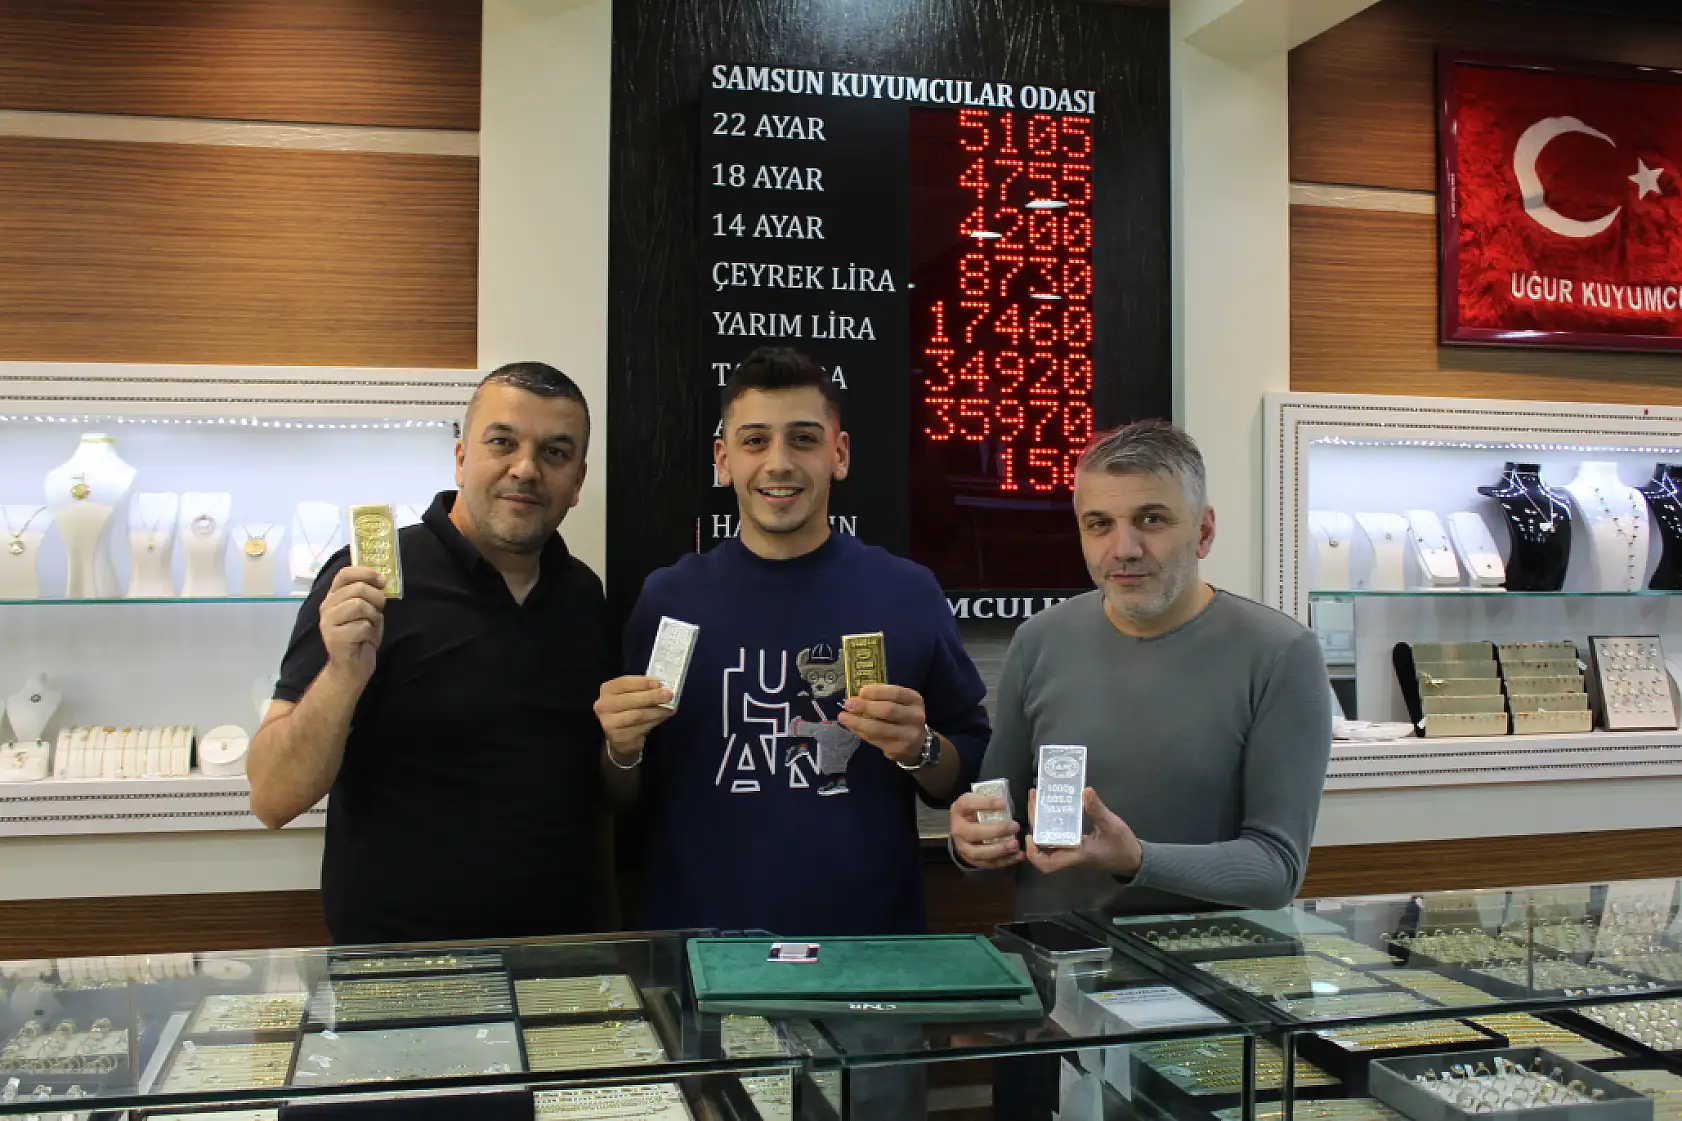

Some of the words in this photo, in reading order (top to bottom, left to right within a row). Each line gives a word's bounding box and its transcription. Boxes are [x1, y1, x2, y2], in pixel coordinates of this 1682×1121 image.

[713, 65, 824, 95] SAMSUN
[832, 72, 1014, 107] KUYUMCULAR
[1019, 88, 1095, 114] ODASI
[713, 113, 745, 136] 22
[754, 114, 826, 140] AYAR
[960, 108, 1092, 157] 5105
[713, 163, 745, 186] 18
[753, 165, 824, 191] AYAR
[960, 158, 1092, 206] 4755
[713, 214, 745, 237] 14
[753, 214, 824, 239] AYAR
[960, 206, 1092, 252] 4200
[713, 262, 824, 291] ÇEYREK
[832, 263, 895, 291] LİRA
[960, 253, 1092, 299] 8730
[1512, 272, 1572, 302] UĞUR
[1582, 282, 1682, 312] KUYUMC
[713, 312, 801, 337] YARIM
[812, 311, 876, 340] LİRA
[931, 301, 1092, 347] 17460
[925, 349, 1092, 395] 34920
[925, 397, 1092, 443] 35970
